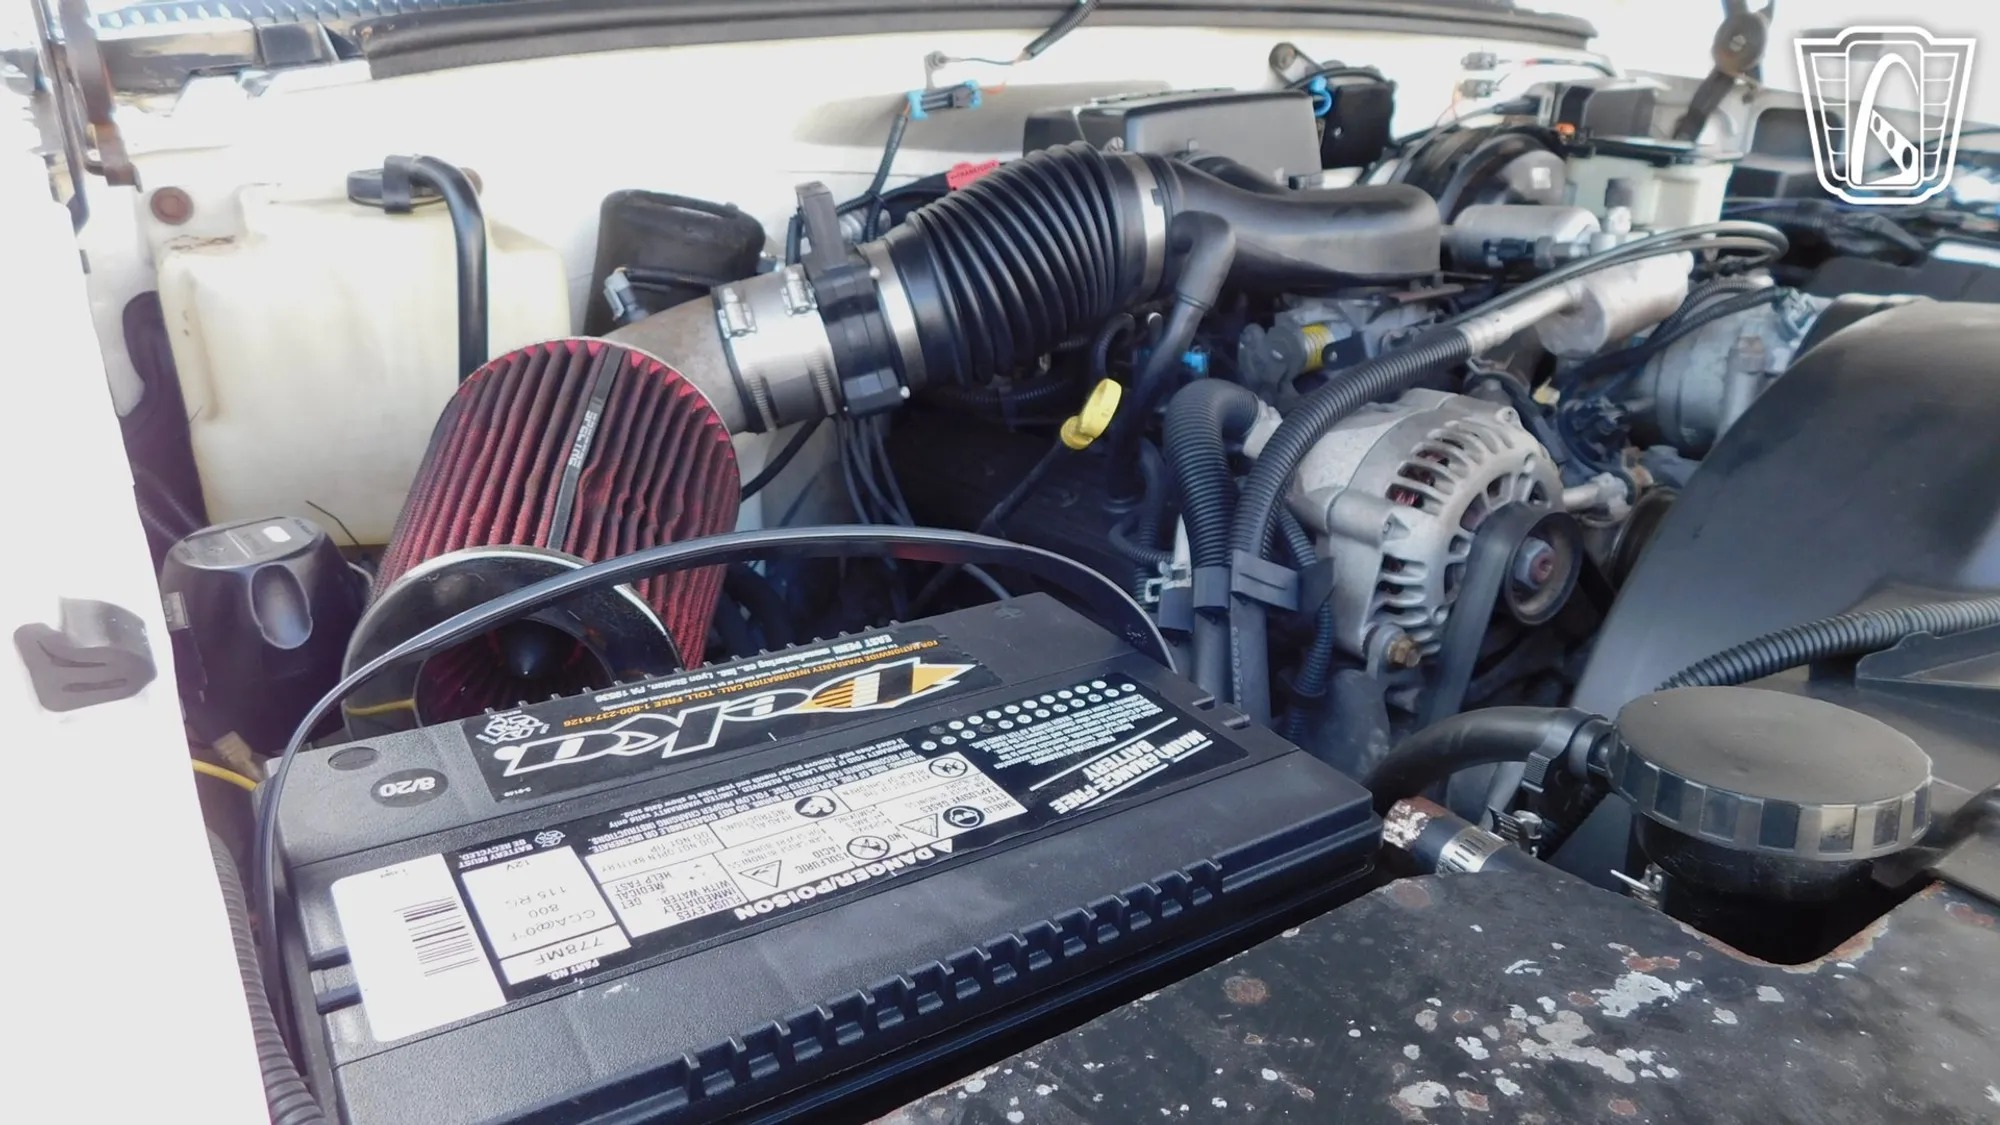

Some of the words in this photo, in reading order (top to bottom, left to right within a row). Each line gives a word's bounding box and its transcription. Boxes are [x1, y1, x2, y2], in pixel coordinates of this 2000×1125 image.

[568, 410, 598, 468] SPECTRE
[863, 634, 892, 647] EAST
[864, 643, 920, 660] NATIONWIDE
[812, 657, 863, 672] WARRANTY
[647, 677, 687, 689] Station,
[688, 672, 713, 681] Lyon
[743, 668, 810, 687] INFORMATION
[629, 686, 645, 694] PA
[687, 690, 714, 699] TOLL
[654, 696, 682, 707] FREE
[867, 742, 909, 757] WARRANTY
[803, 756, 836, 768] Remove
[843, 754, 899, 774] RECOMMENDED
[846, 754, 867, 763] VOID
[1081, 739, 1155, 778] BATTERY
[778, 764, 803, 775] proper
[792, 767, 818, 777] LABEL
[817, 762, 837, 771] THIS
[825, 770, 843, 779] FOR
[856, 769, 870, 778] OF
[376, 775, 438, 799] 8/20
[716, 783, 735, 792] year
[735, 779, 751, 787] and
[791, 778, 838, 796] EXPLOSION
[702, 789, 738, 803] LIMITED
[735, 791, 769, 804] FOLLOW
[951, 785, 998, 803] EXPLOSIVE
[982, 792, 1006, 803] EYES
[643, 803, 663, 811] date
[653, 799, 702, 816] WARRANTY
[664, 796, 686, 806] show
[700, 800, 735, 814] PROPER
[734, 803, 750, 812] DO
[919, 800, 950, 812] GASES
[982, 799, 1014, 813] SHIELD
[628, 813, 651, 823] valid
[656, 810, 700, 826] CHARGING
[716, 807, 737, 817] NOT
[609, 818, 628, 827] only
[590, 822, 656, 844] INSTRUCTIONS.
[641, 828, 659, 839] OR
[692, 831, 709, 839] DO
[649, 843, 665, 851] TIP
[671, 837, 691, 846] NOT
[679, 843, 697, 852] NOT
[698, 837, 714, 846] DO
[459, 842, 511, 860] RECYCLED.
[490, 844, 533, 859] BATTERY
[646, 848, 674, 860] OPEN
[811, 845, 836, 858] ACID
[459, 856, 488, 867] MUST
[505, 860, 529, 870] 12V
[794, 853, 841, 873] SULFURIC
[644, 871, 671, 884] HELP
[732, 846, 935, 919] DANGER/POISON
[615, 879, 642, 892] FAST
[616, 882, 665, 899] MEDICAL
[701, 879, 729, 892] WITH
[536, 886, 566, 899] 115
[621, 896, 642, 909] GET
[664, 887, 736, 913] IMMEDIATELY
[706, 895, 742, 910] FLUSH
[528, 903, 559, 916] 800
[675, 905, 705, 920] EYES
[534, 938, 600, 963] 778MF
[568, 958, 600, 974] PART
[545, 971, 569, 981] NO.
